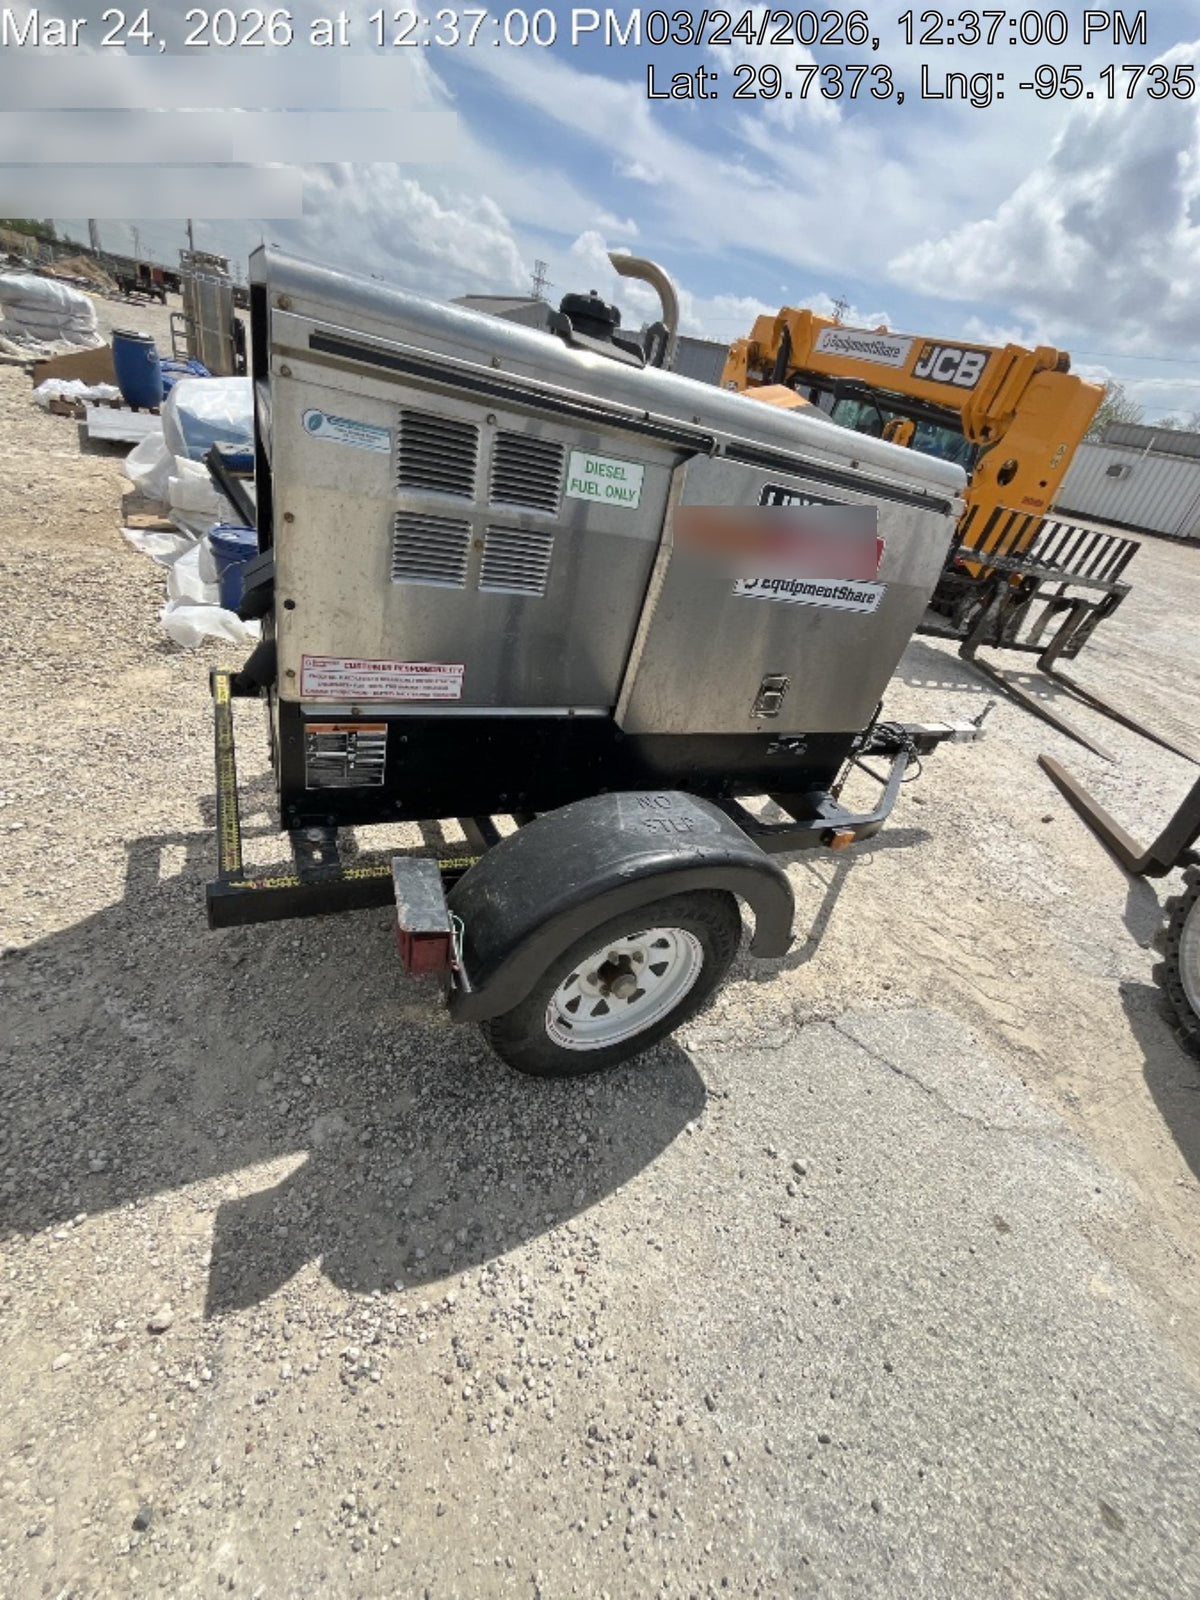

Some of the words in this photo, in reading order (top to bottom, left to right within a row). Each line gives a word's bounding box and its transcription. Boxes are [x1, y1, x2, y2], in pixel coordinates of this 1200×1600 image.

[914, 346, 987, 387] JCB
[585, 460, 628, 481] DIESEL
[570, 478, 601, 497] FUEL
[605, 485, 637, 502] ONLY
